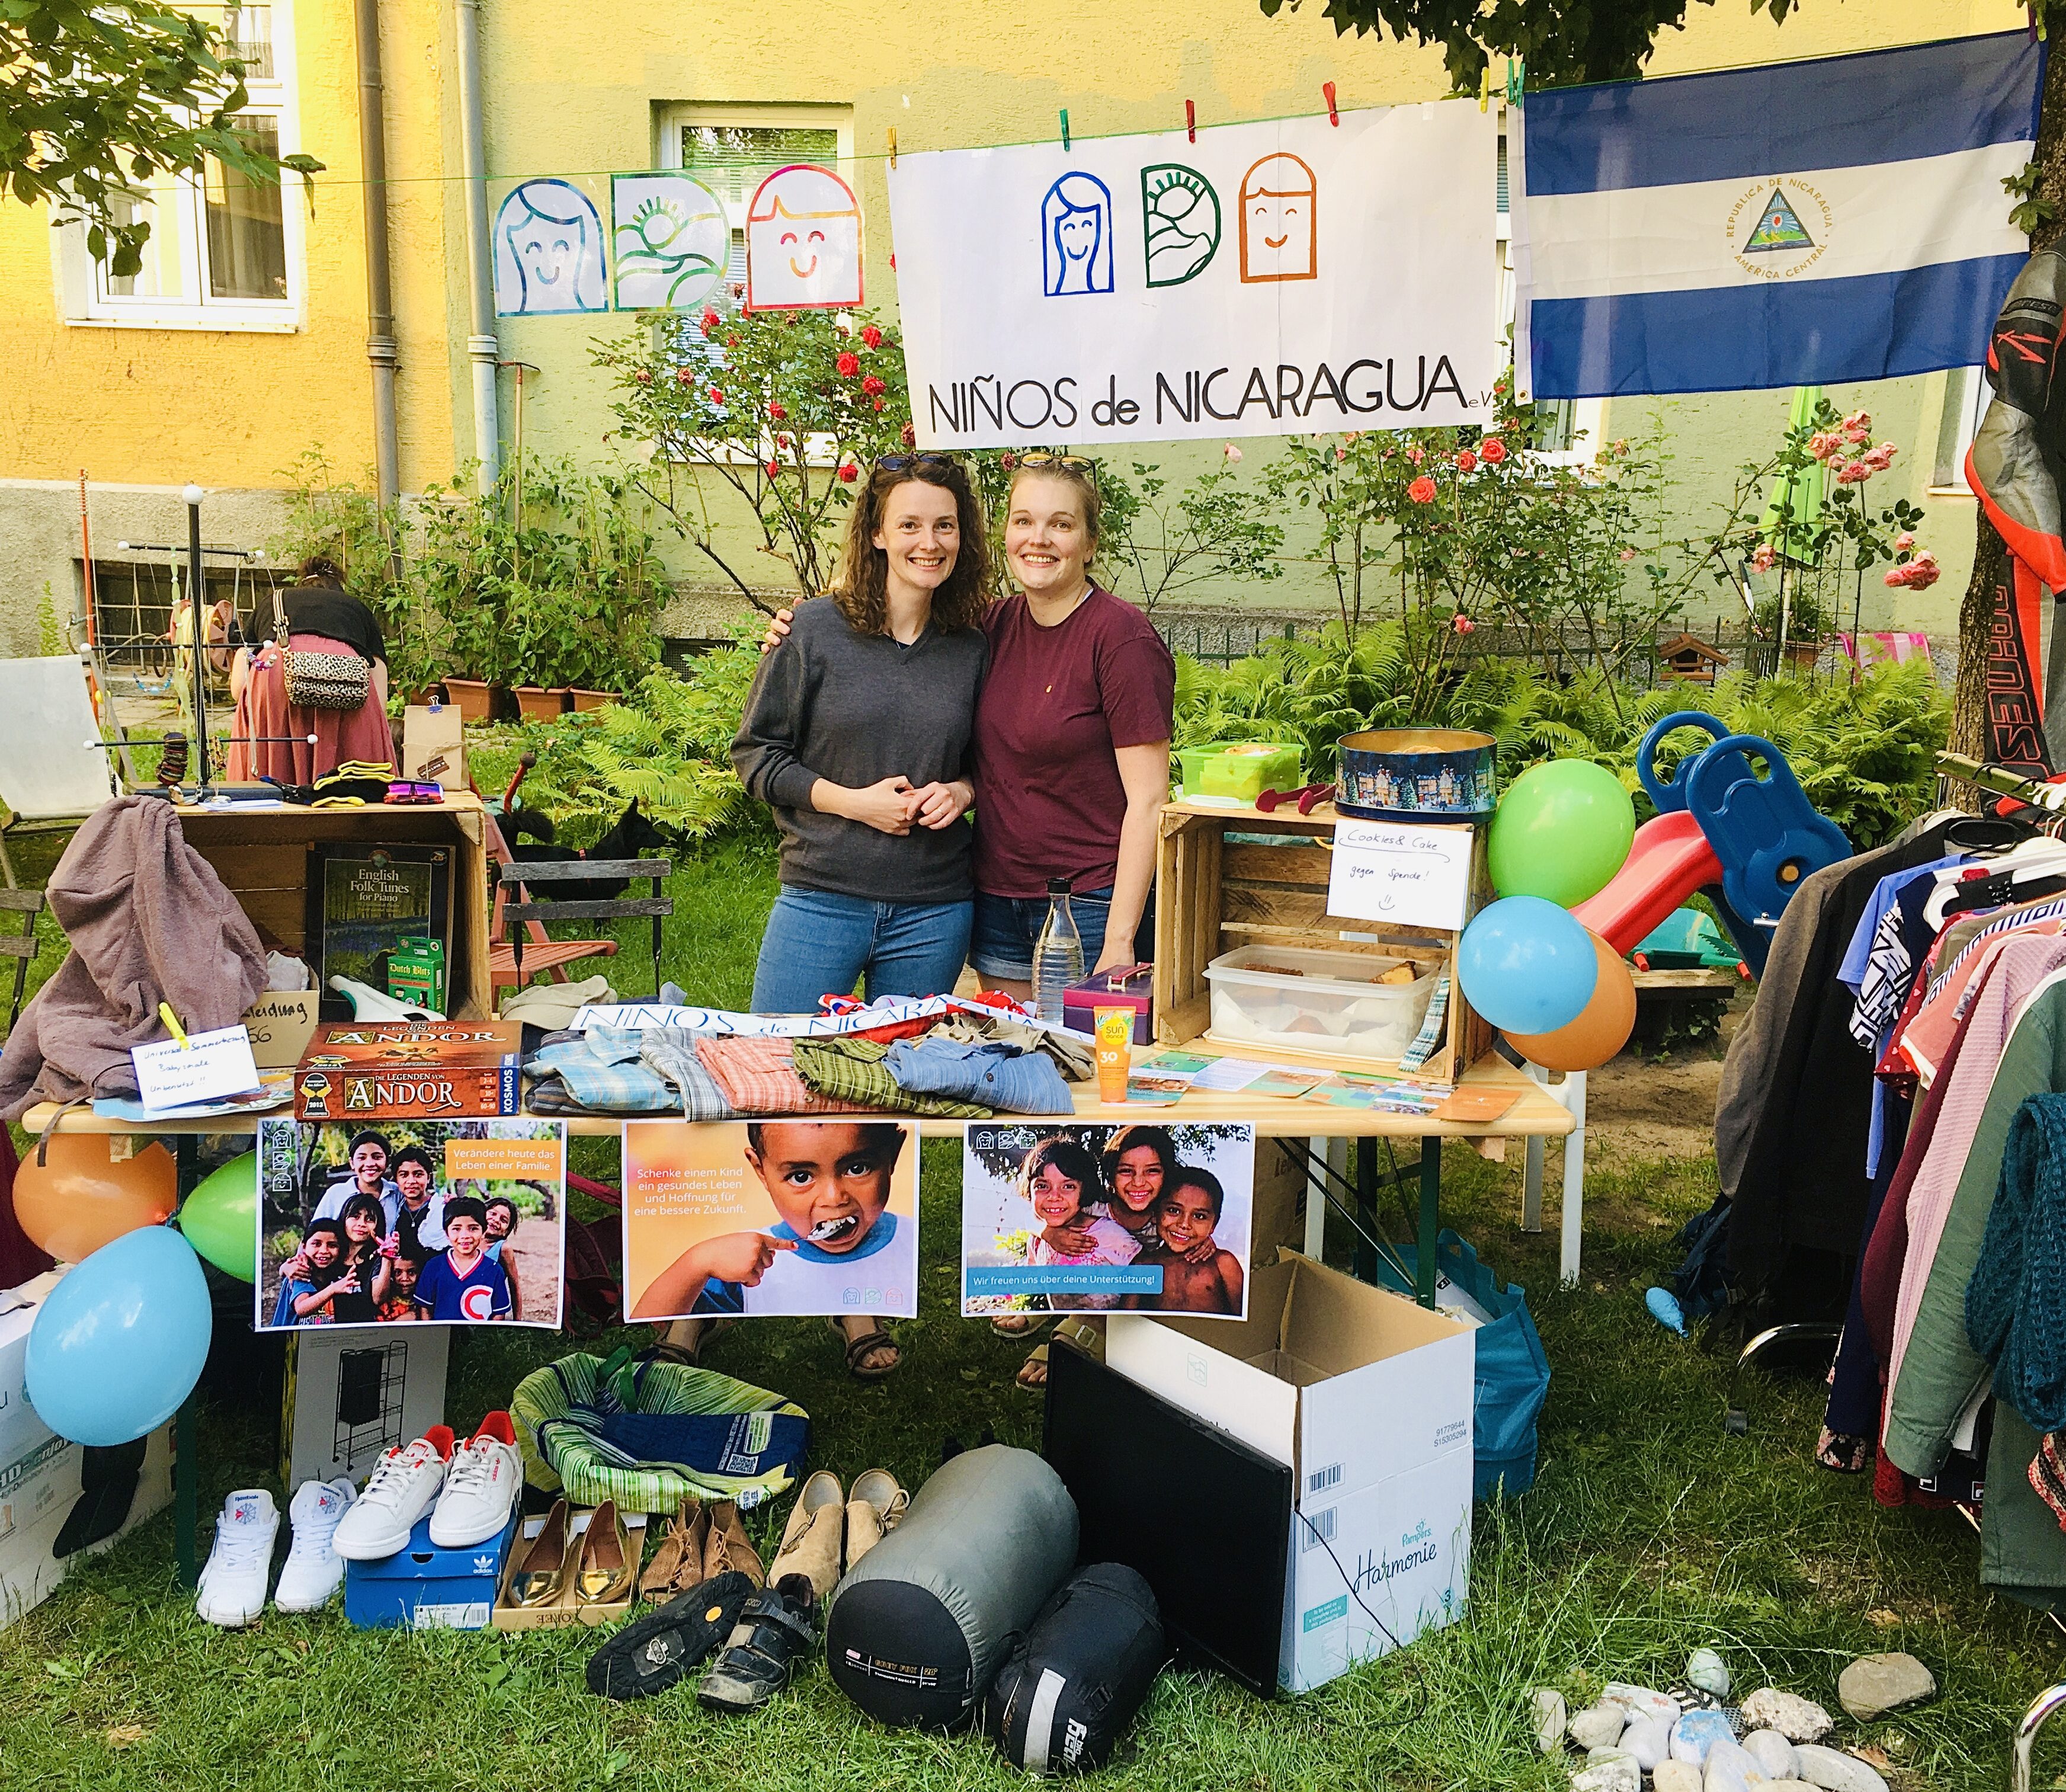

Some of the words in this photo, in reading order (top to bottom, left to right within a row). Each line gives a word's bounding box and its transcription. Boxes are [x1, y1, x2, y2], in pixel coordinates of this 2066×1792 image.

[1726, 185, 1764, 237] REPUBLICA
[1769, 178, 1782, 187] DE
[1789, 178, 1833, 228] NICARAGUA
[1734, 255, 1780, 279] AMERICA
[1786, 244, 1827, 277] CENTRAL
[928, 375, 1077, 434] NIÑOS
[1091, 375, 1140, 427] de
[1157, 355, 1468, 425] NICARAGUA
[1412, 837, 1438, 850] Cake
[358, 869, 399, 882] English
[1350, 866, 1374, 877] gegen
[350, 881, 375, 892] Folk
[377, 882, 409, 893] Tunes
[359, 892, 373, 901] for
[374, 893, 398, 902] Piano
[389, 964, 410, 974] Dutch
[412, 965, 431, 976] Blitz
[580, 1004, 734, 1032] NIÑOS
[760, 1018, 788, 1033] de
[328, 1032, 507, 1045] ANDOR
[1100, 1051, 1118, 1064] 30
[387, 1073, 430, 1081] LEGENDEN
[347, 1079, 462, 1112] ANDOR
[504, 1069, 513, 1112] KOSMOS
[453, 1148, 505, 1159] Verändere
[508, 1150, 536, 1159] heute
[537, 1150, 555, 1159] das
[456, 1160, 486, 1170] Leben
[489, 1161, 514, 1170] einer
[516, 1160, 553, 1171] Familie.
[637, 1169, 681, 1179] Schenke
[684, 1168, 716, 1177] einem
[719, 1167, 743, 1176] Kind
[638, 1181, 654, 1191] ein
[657, 1180, 707, 1192] gesundes
[710, 1179, 742, 1189] Leben
[645, 1193, 666, 1202] und
[669, 1192, 718, 1204] Hoffnung
[720, 1191, 736, 1201] für
[634, 1206, 656, 1215] eine
[659, 1205, 700, 1215] bessere
[703, 1204, 747, 1214] Zukunft.
[973, 1276, 989, 1285] Wir
[990, 1275, 1020, 1285] freuen
[1022, 1276, 1038, 1285] uns
[1040, 1275, 1061, 1284] über
[1063, 1275, 1087, 1284] deine
[1090, 1275, 1155, 1286] Unterstützung!
[1402, 1528, 1431, 1547] Pampers
[1353, 1542, 1437, 1593] Harmonie
[1444, 1589, 1451, 1602] 3
